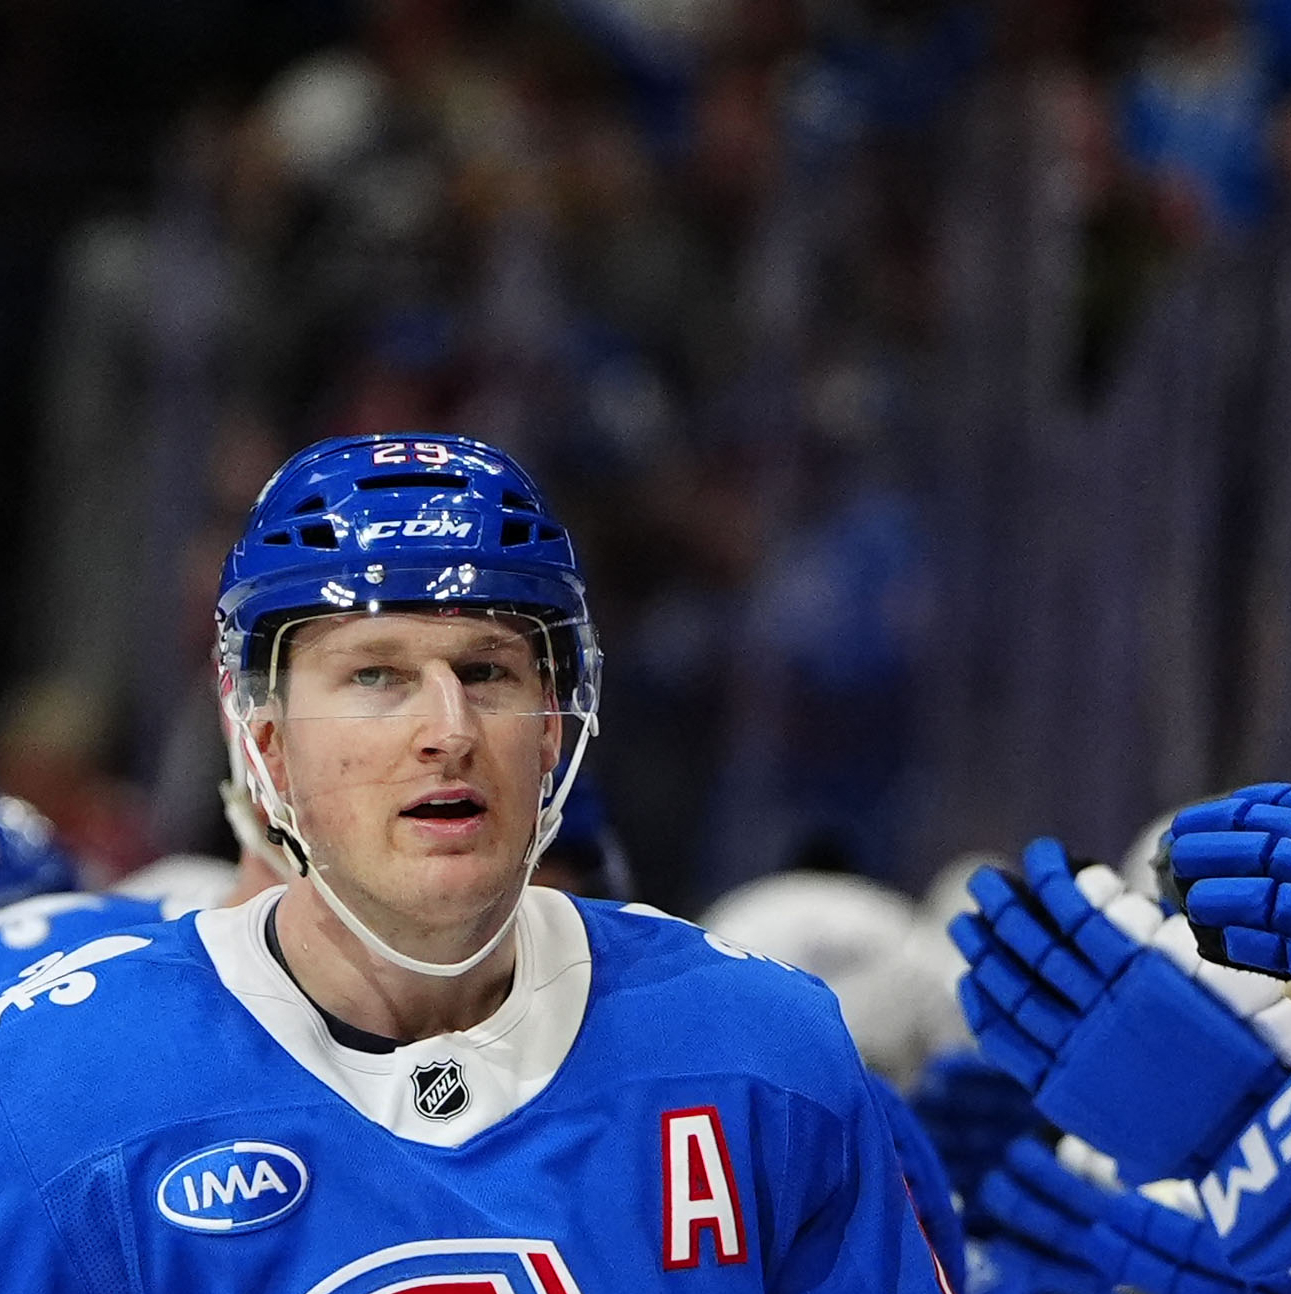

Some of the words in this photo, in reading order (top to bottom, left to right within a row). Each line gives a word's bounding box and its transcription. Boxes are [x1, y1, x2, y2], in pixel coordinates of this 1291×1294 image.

[372, 442, 449, 465] 29
[368, 519, 473, 539] CCM
[426, 1073, 457, 1111] NHL
[181, 1158, 288, 1211] IMA
[660, 1105, 748, 1272] A
